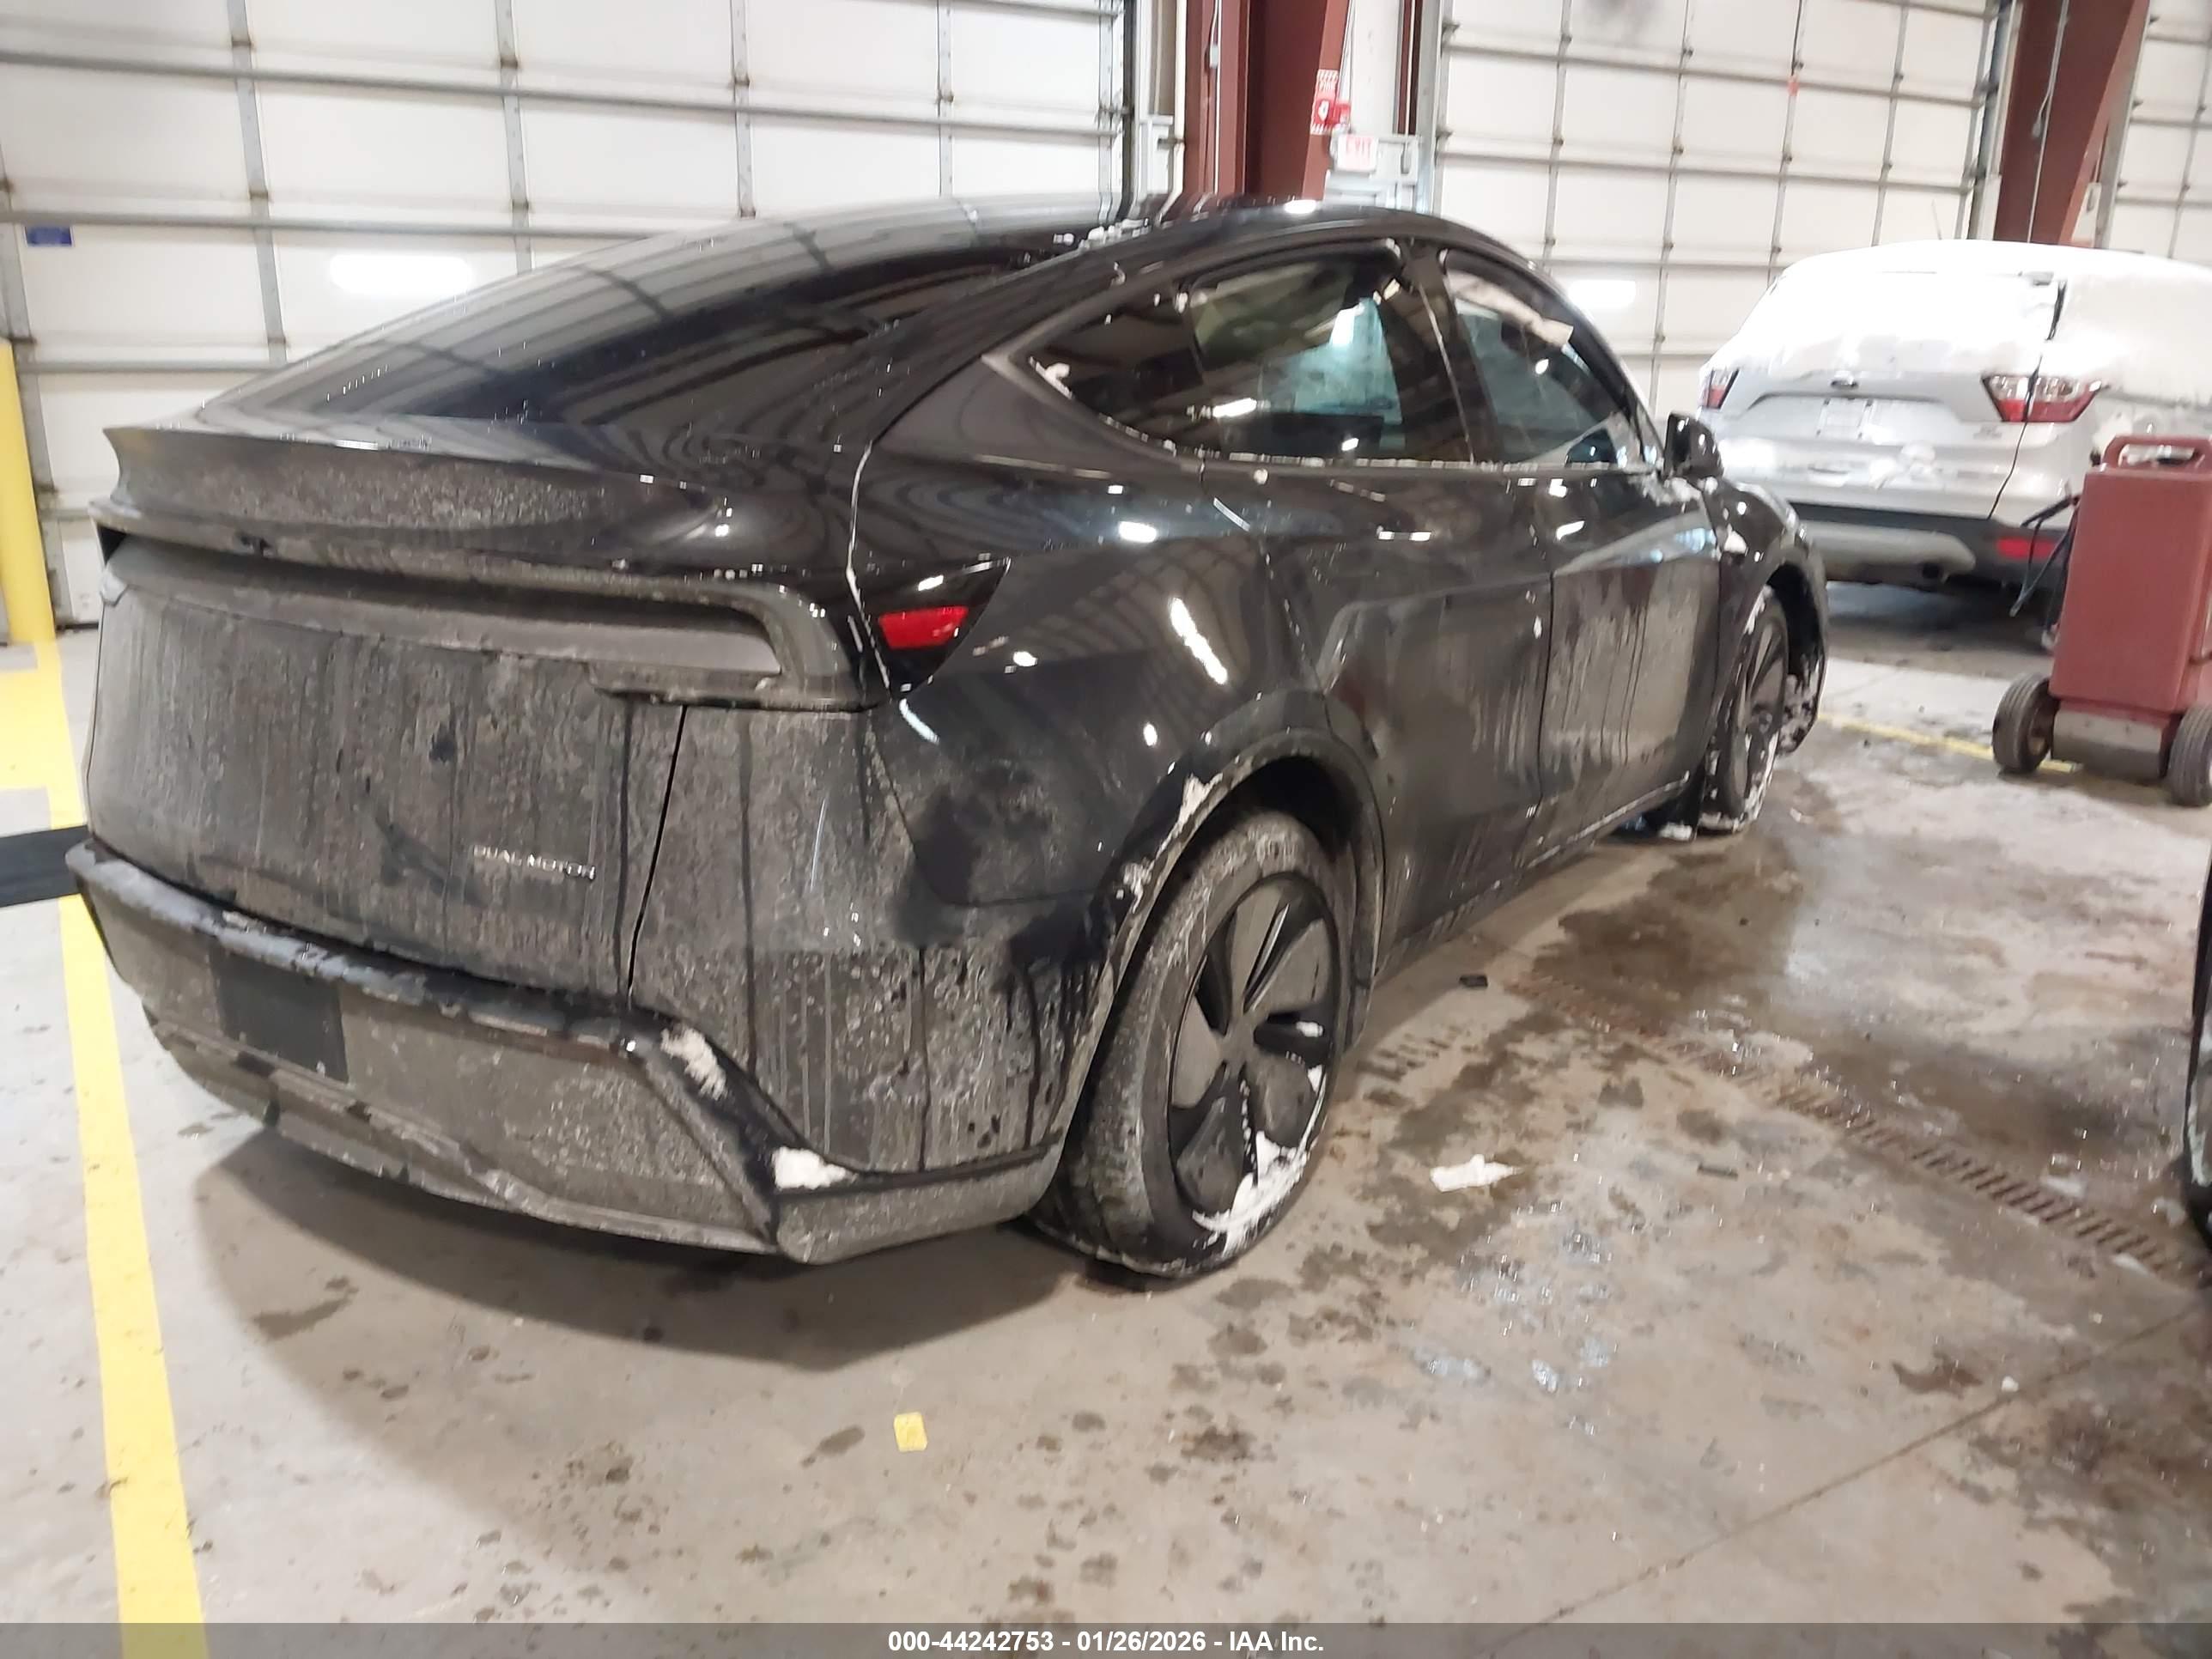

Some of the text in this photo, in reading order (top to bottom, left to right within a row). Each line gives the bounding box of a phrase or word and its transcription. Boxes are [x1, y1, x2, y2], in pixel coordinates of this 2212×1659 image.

[1346, 135, 1373, 157] EXIT
[473, 844, 596, 880] DUAL MOTOR
